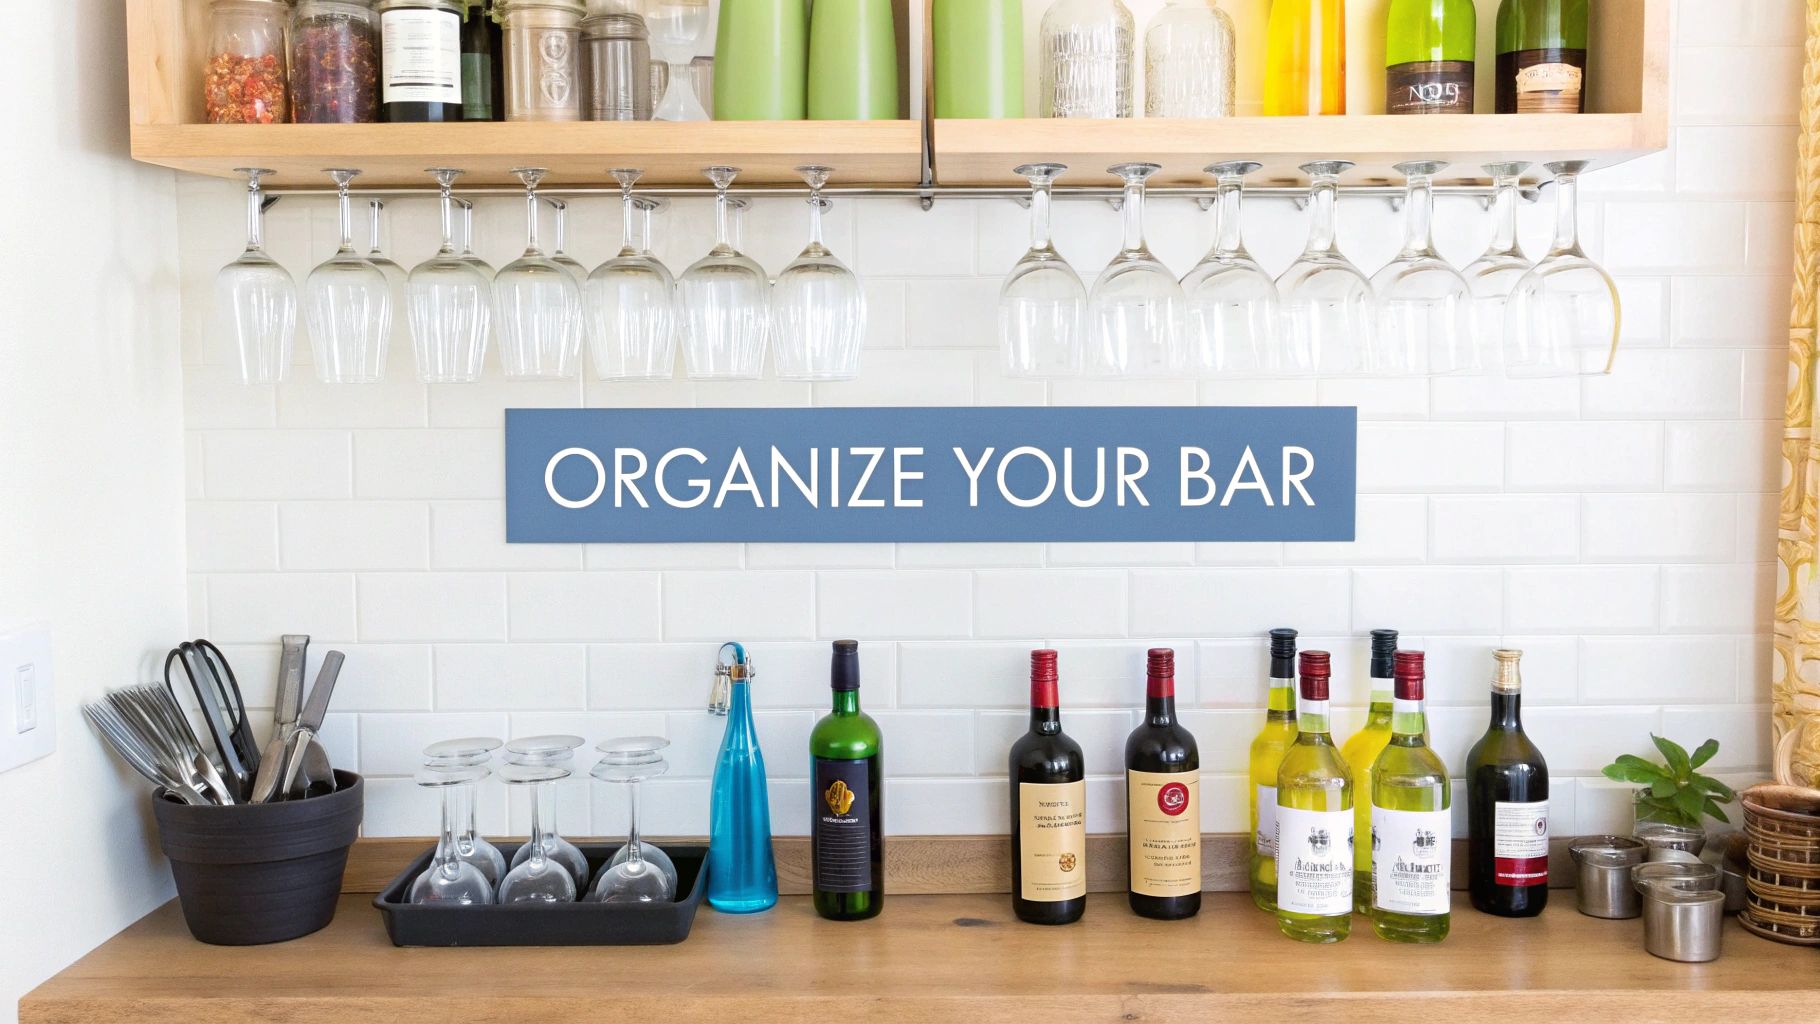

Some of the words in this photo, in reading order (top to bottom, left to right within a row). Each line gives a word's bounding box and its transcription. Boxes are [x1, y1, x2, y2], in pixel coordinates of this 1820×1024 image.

[544, 447, 924, 509] ORGANIZE
[952, 446, 1151, 508] YOUR
[1180, 445, 1316, 507] BAR
